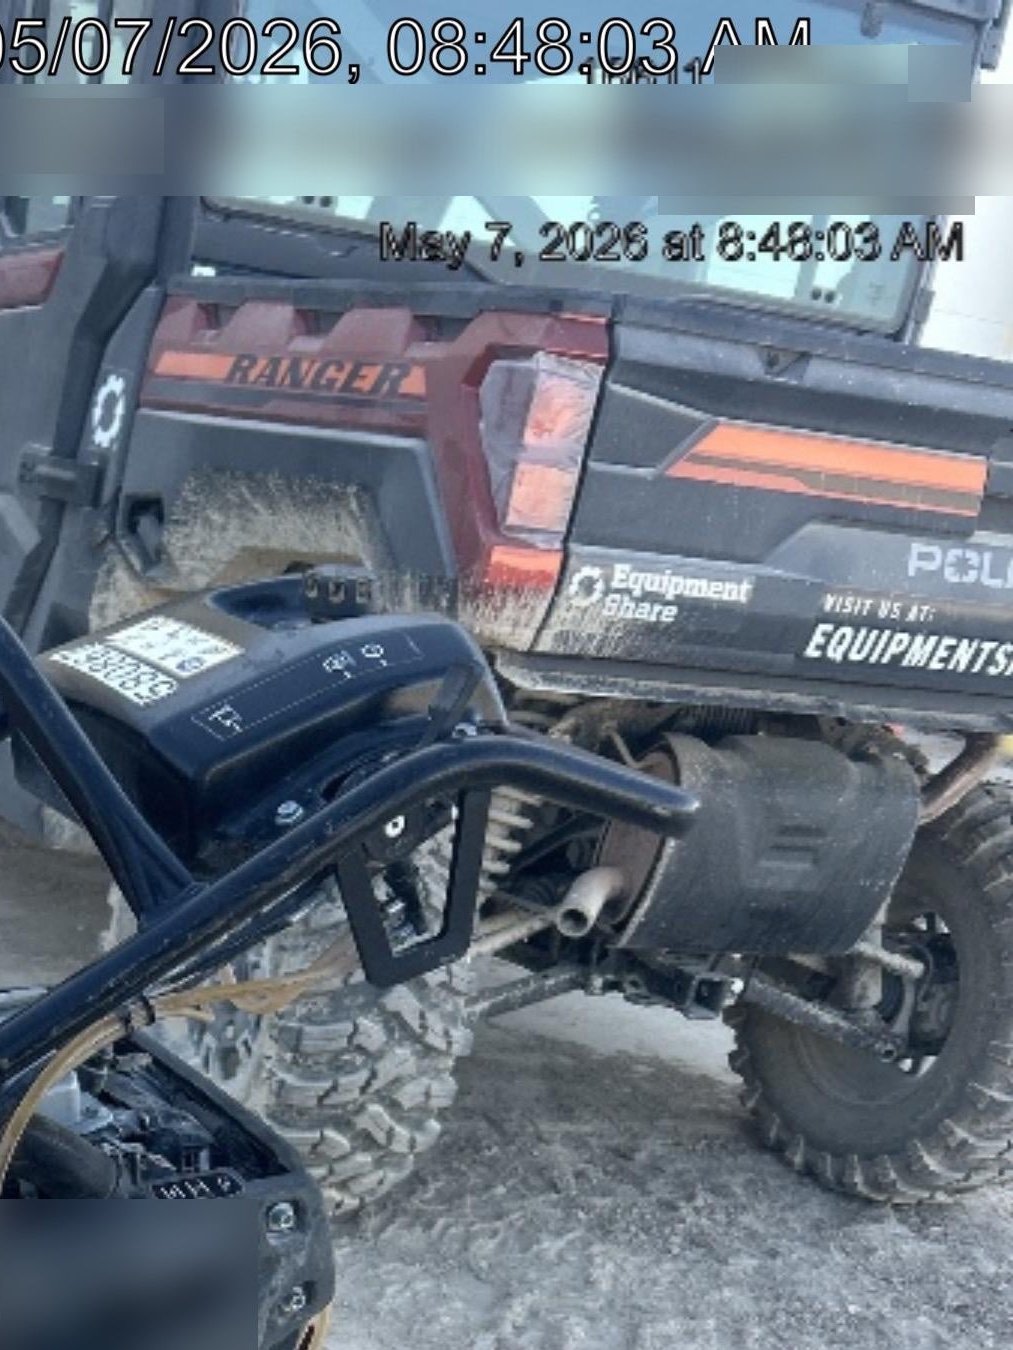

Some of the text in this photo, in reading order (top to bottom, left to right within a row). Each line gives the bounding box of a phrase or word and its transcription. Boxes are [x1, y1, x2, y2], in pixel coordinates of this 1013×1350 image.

[224, 353, 412, 399] RANGER
[610, 563, 755, 602] Equipment
[601, 593, 678, 621] Share
[824, 593, 874, 616] VISIT
[878, 599, 904, 619] US
[804, 622, 1013, 676] EQUIPMENTS
